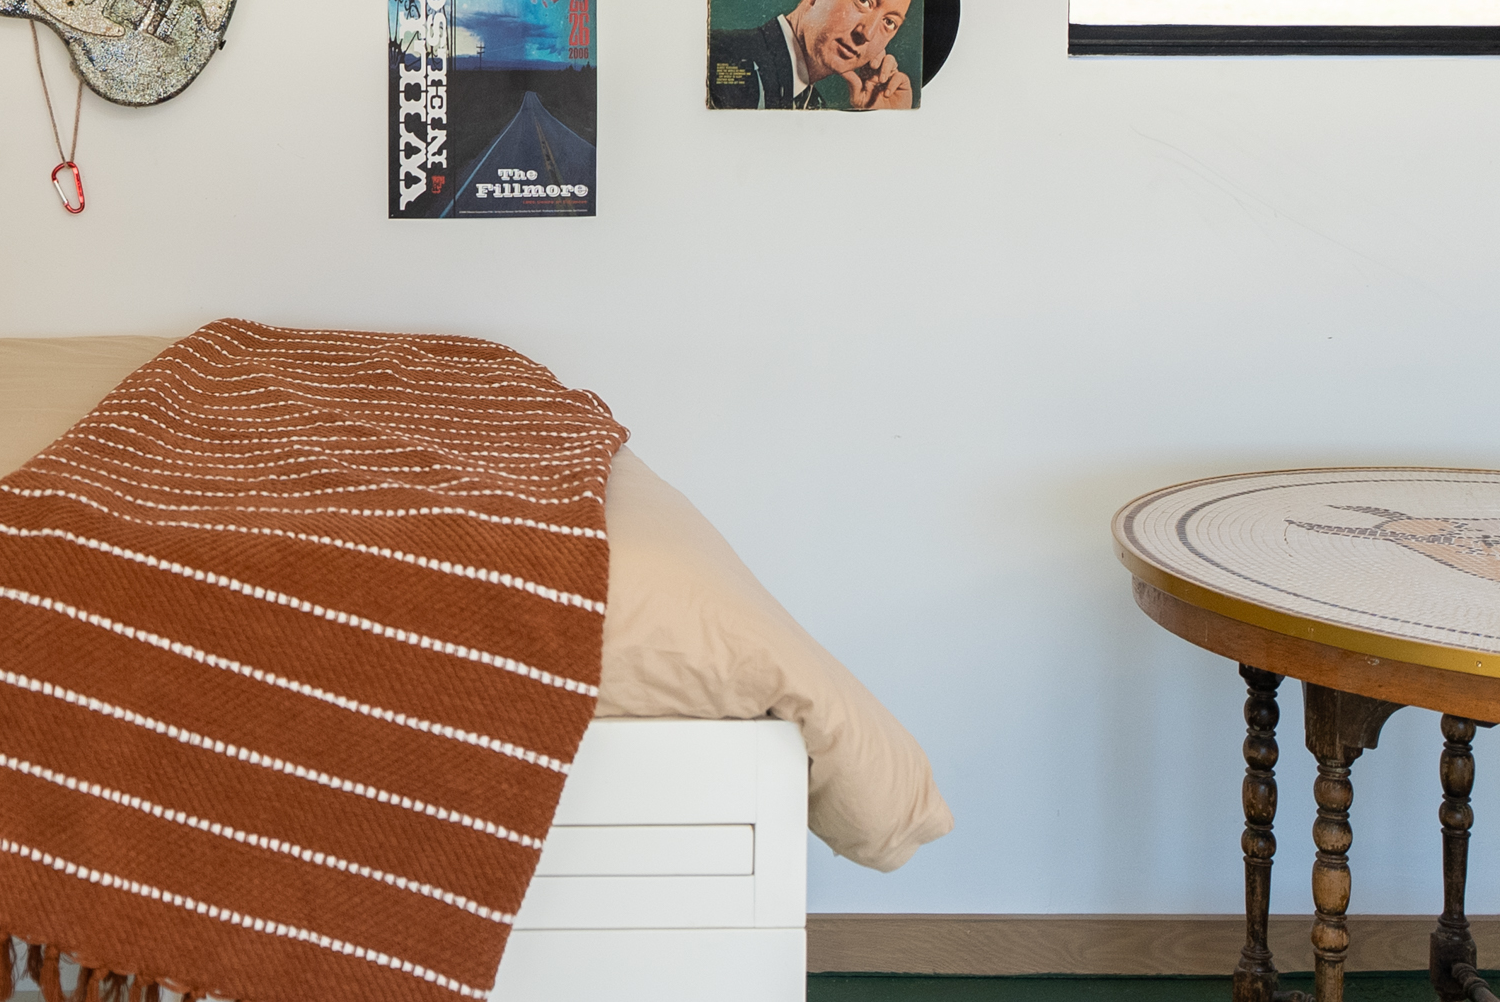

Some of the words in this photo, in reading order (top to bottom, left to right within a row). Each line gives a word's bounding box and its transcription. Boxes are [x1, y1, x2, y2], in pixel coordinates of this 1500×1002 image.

[568, 13, 590, 46] 26
[568, 48, 589, 59] 2006
[497, 168, 539, 181] The
[475, 183, 589, 198] Fillmore
